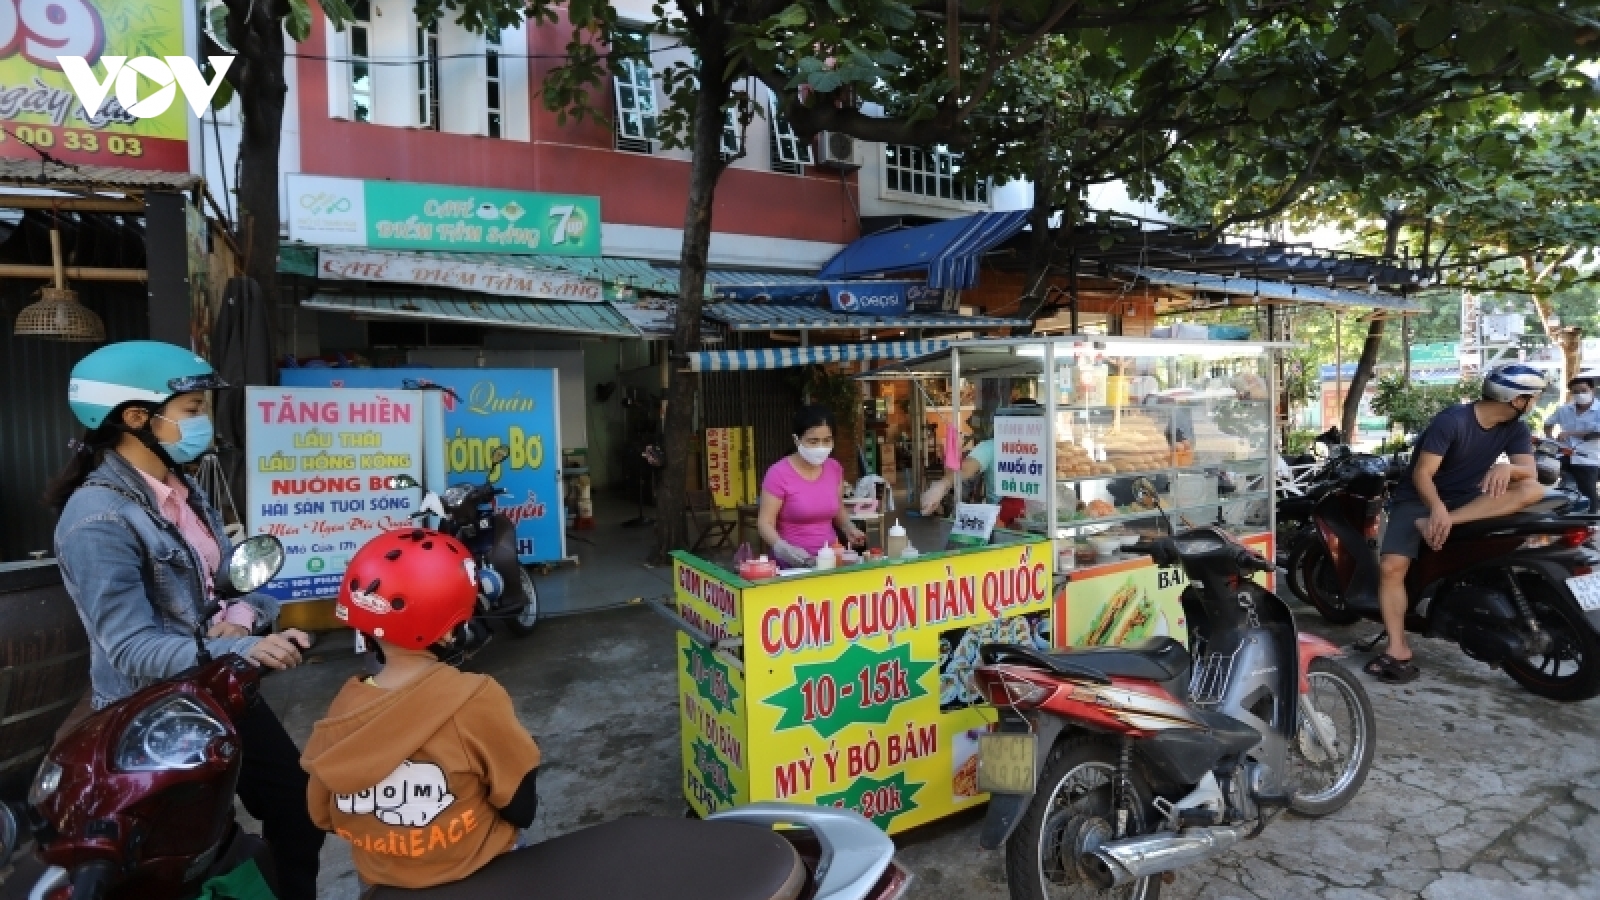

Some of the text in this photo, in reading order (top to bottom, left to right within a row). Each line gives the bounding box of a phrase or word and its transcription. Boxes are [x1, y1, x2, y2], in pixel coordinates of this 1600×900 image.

[0, 0, 106, 71] 9
[63, 131, 98, 151] 33
[107, 135, 142, 156] 03
[257, 394, 340, 423] TĂNG
[348, 394, 412, 423] HIỀN
[469, 381, 536, 414] Quán
[761, 595, 832, 656] CƠM
[841, 575, 917, 642] CUỘN
[981, 546, 1046, 618] QUỐC
